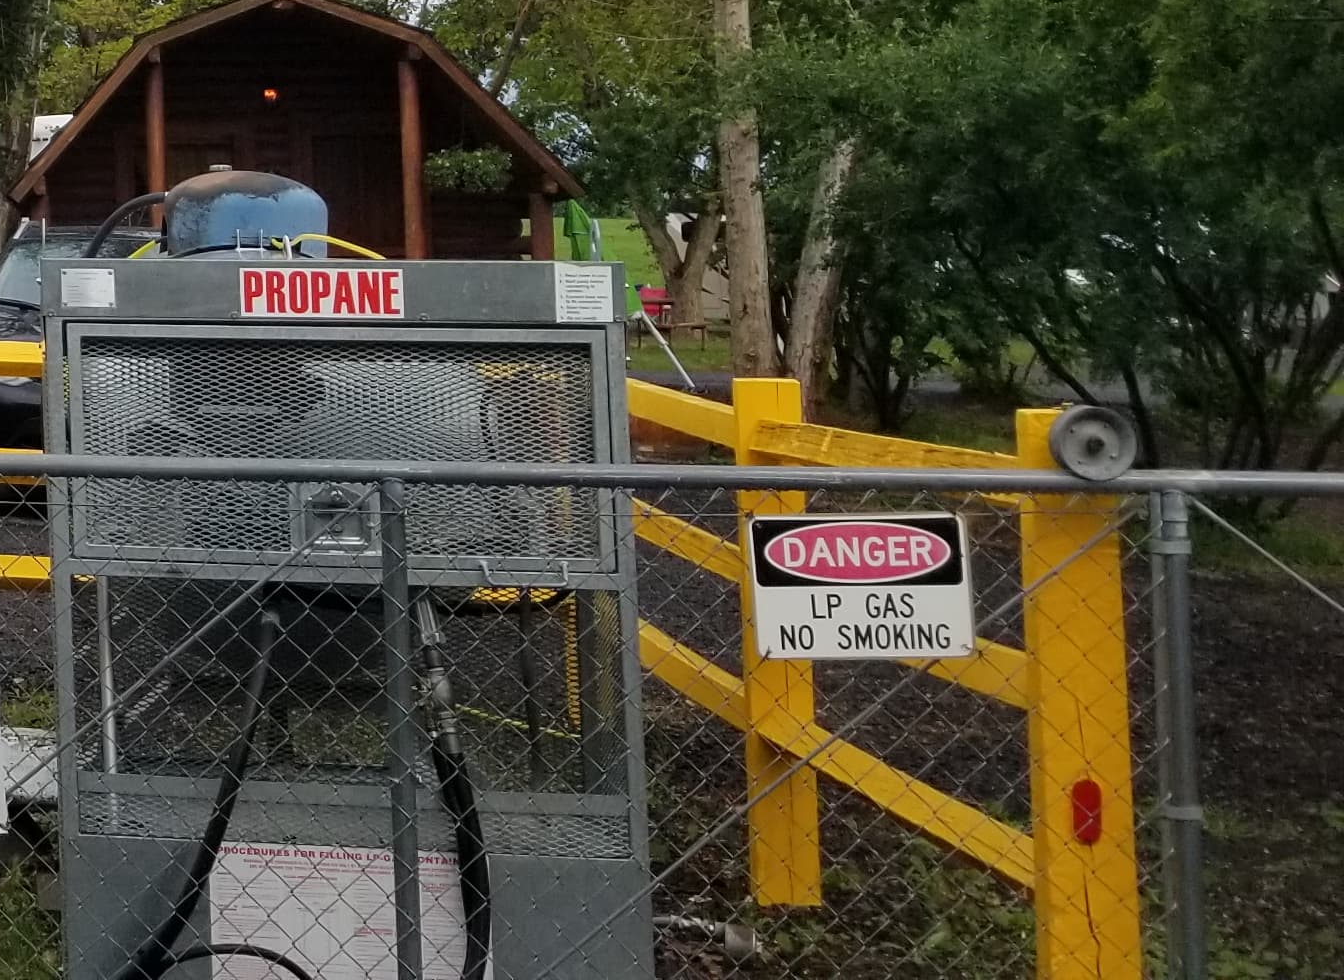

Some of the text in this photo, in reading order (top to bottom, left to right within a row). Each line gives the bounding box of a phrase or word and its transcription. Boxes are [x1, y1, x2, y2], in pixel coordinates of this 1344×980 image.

[243, 270, 400, 314] PROPANE
[782, 535, 933, 568] DANGER
[810, 593, 914, 619] LP GAS
[780, 624, 950, 650] NO SMOKING
[219, 847, 289, 857] PROCEDURES
[294, 850, 315, 858] FOR
[320, 851, 362, 860] FILLING
